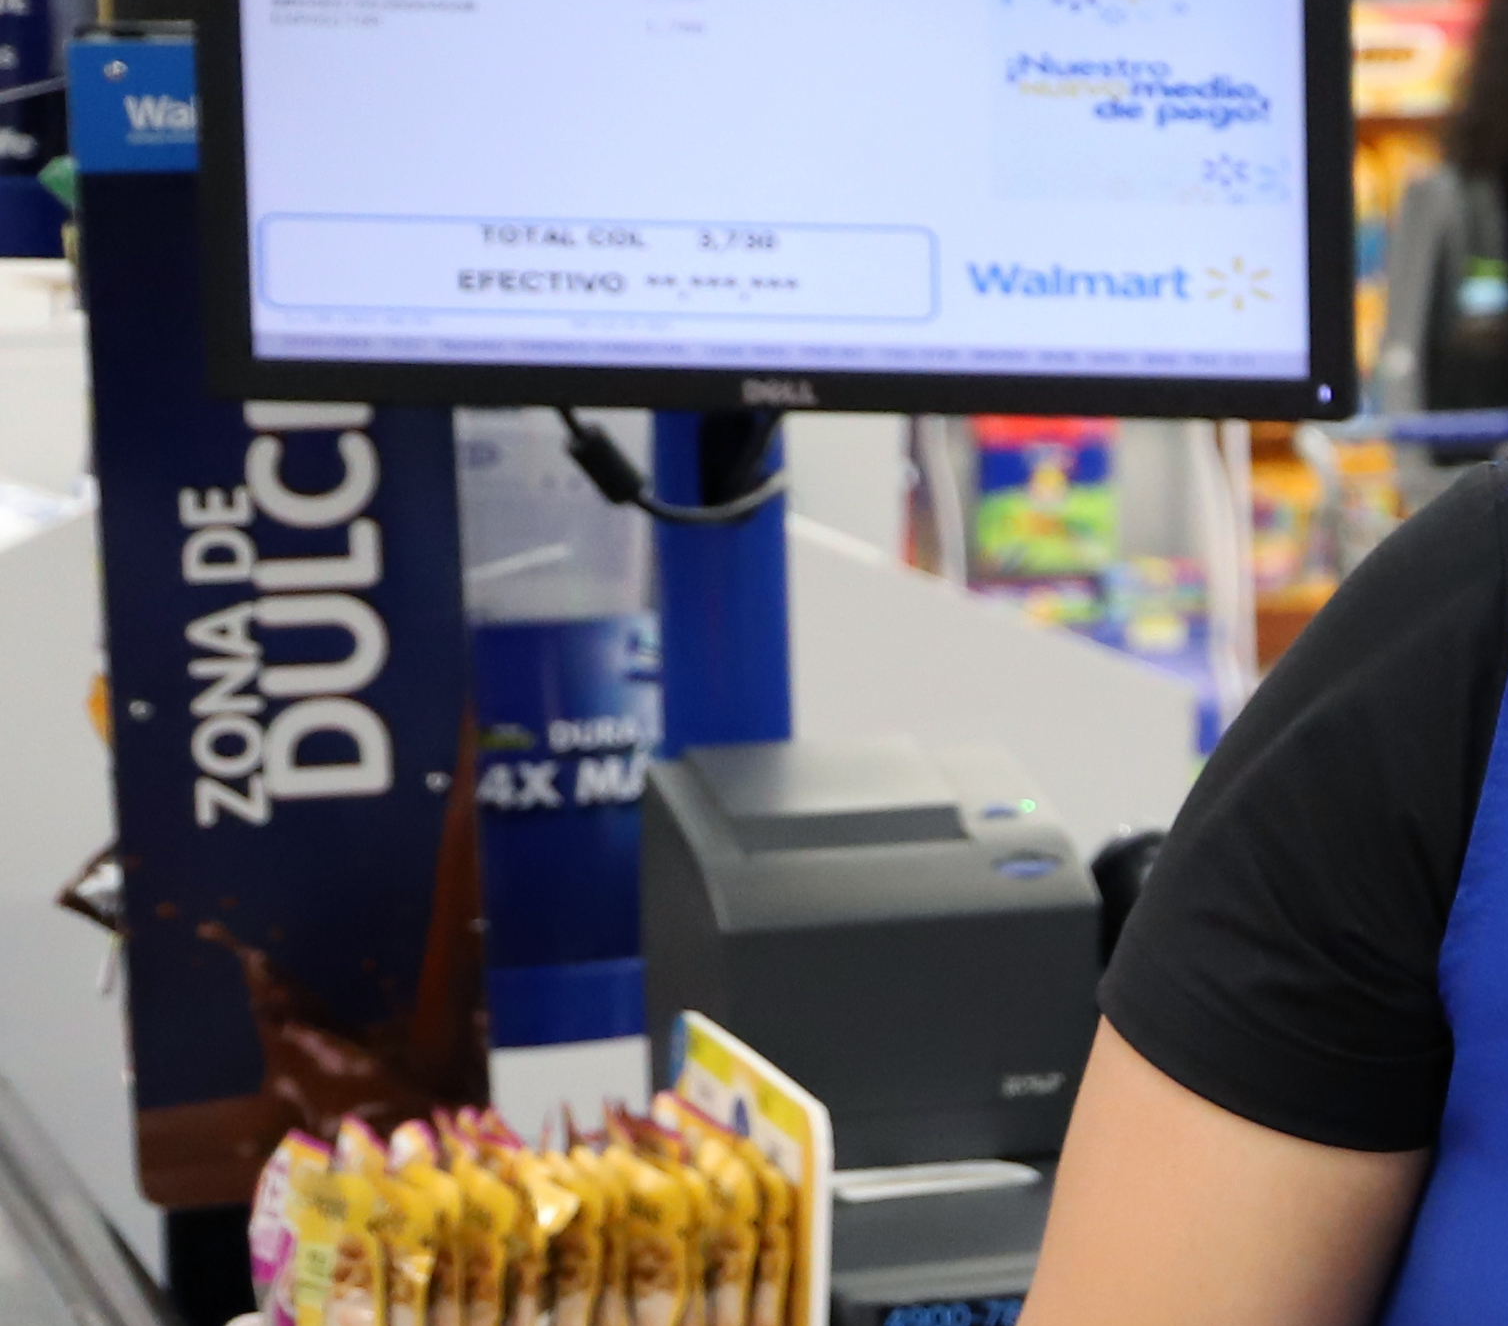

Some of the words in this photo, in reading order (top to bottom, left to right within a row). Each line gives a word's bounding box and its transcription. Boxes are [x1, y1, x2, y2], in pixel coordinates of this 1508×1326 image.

[1093, 100, 1148, 121] de
[481, 223, 576, 249] TOTAL
[587, 225, 645, 249] COL
[457, 269, 627, 296] EFECTIVO
[966, 262, 1190, 299] Walmart
[178, 486, 258, 586] DE
[186, 602, 272, 828] ZONA
